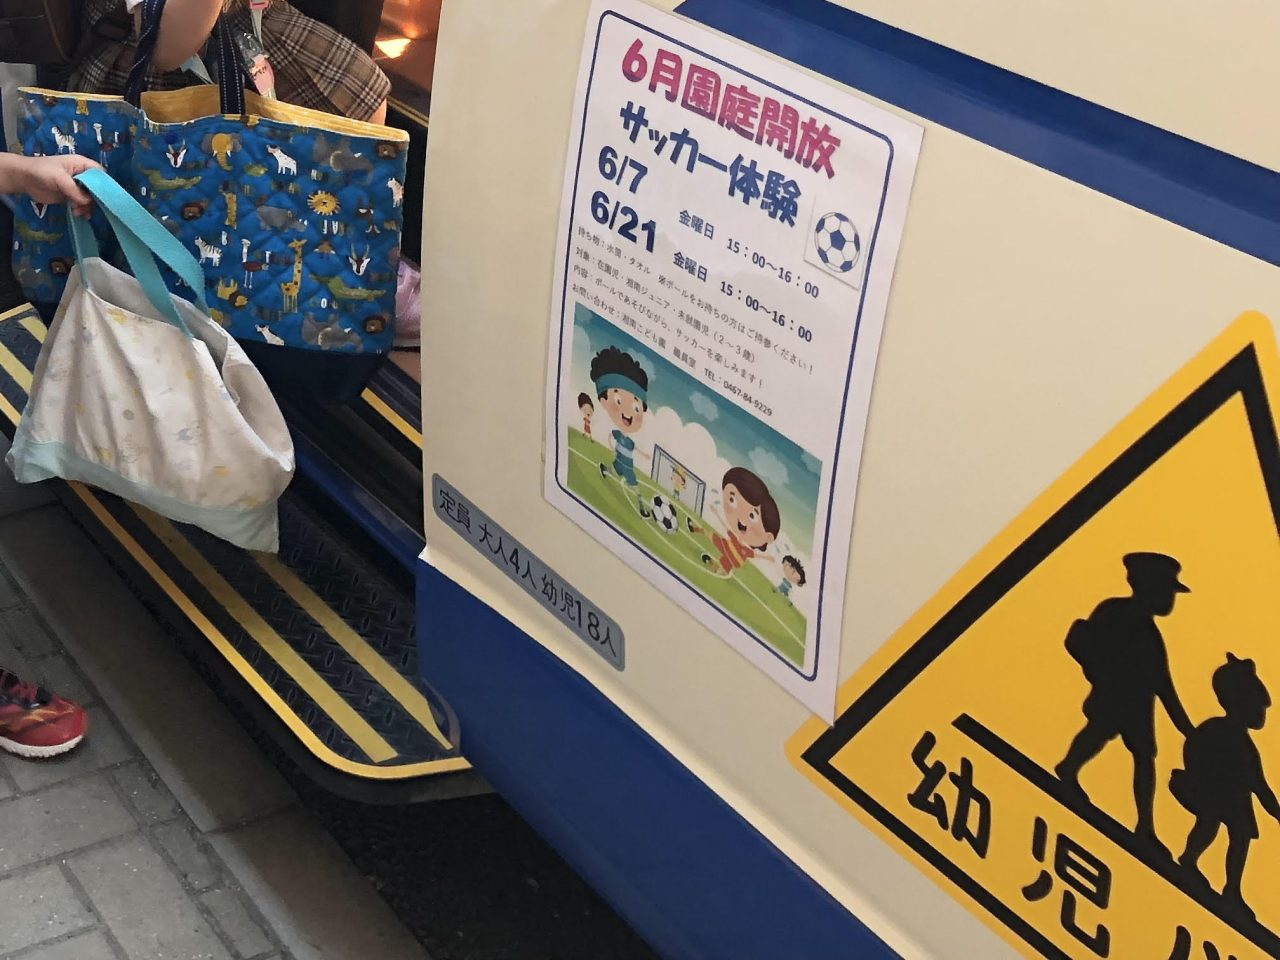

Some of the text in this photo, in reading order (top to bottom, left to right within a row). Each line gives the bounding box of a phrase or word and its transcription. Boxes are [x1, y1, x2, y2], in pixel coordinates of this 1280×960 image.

[620, 101, 802, 228] サッカー体験
[622, 38, 841, 179] 6月園庭開放
[591, 191, 656, 253] 6/21
[673, 251, 707, 282] 金曜日
[598, 146, 648, 194] 6/7
[679, 210, 714, 240] 金曜日
[439, 489, 617, 658] 定員 大人4人 幼児18人
[907, 730, 1238, 960] 幼児
